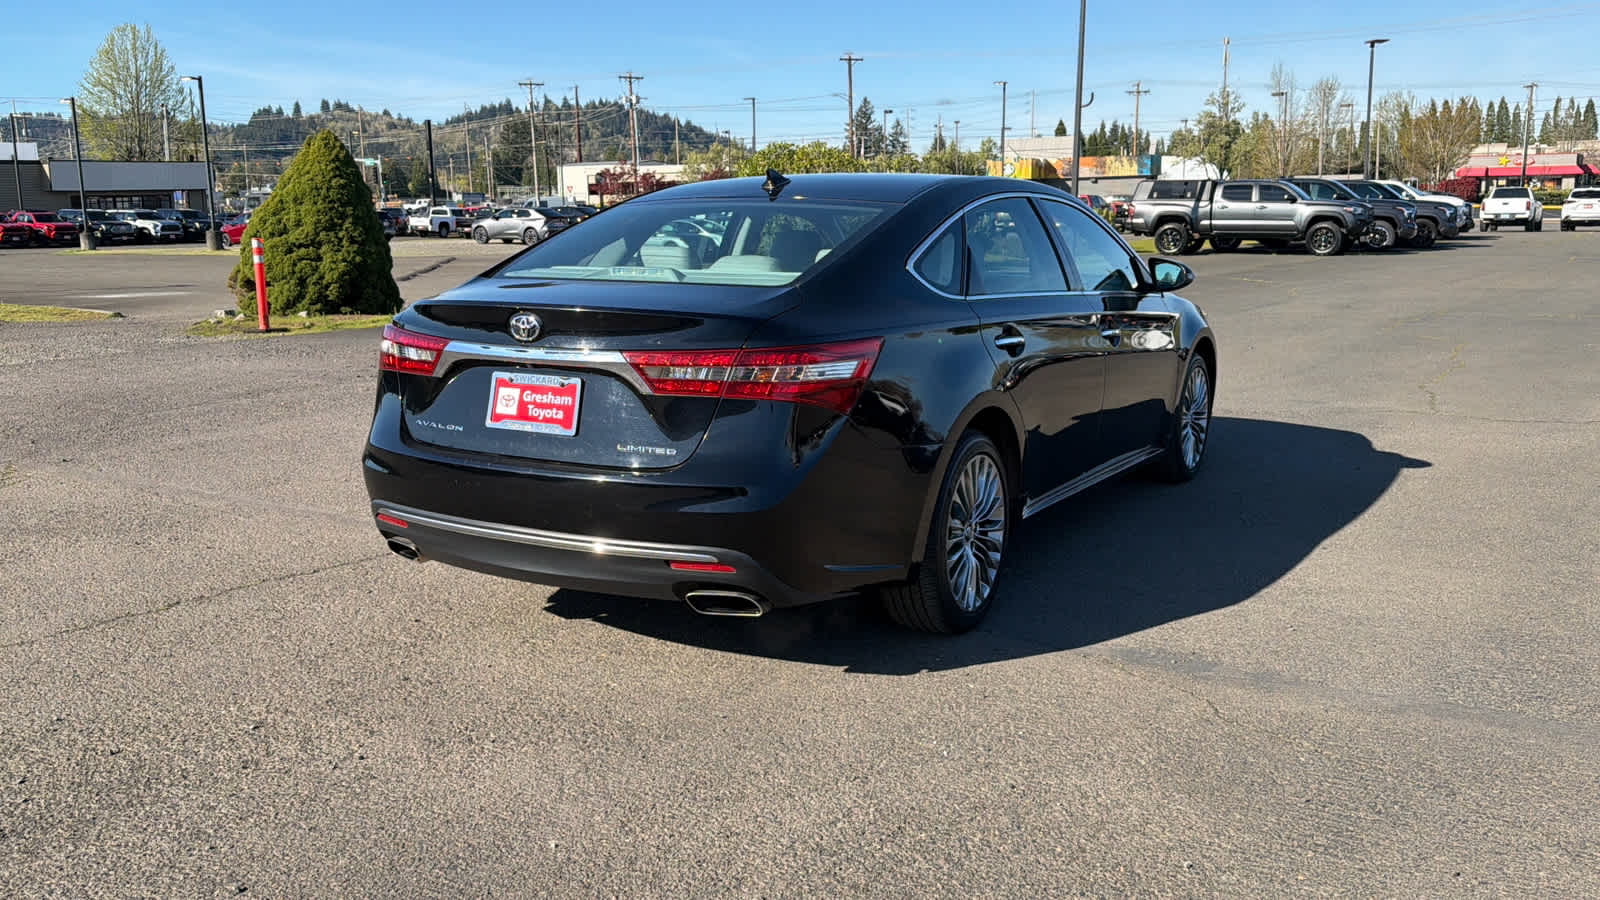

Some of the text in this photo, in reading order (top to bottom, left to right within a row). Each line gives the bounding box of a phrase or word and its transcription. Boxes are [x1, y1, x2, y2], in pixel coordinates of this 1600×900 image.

[522, 390, 572, 406] Gresham
[527, 404, 564, 420] Toyota
[415, 419, 464, 431] AVALON
[616, 443, 678, 455] LIMITED
